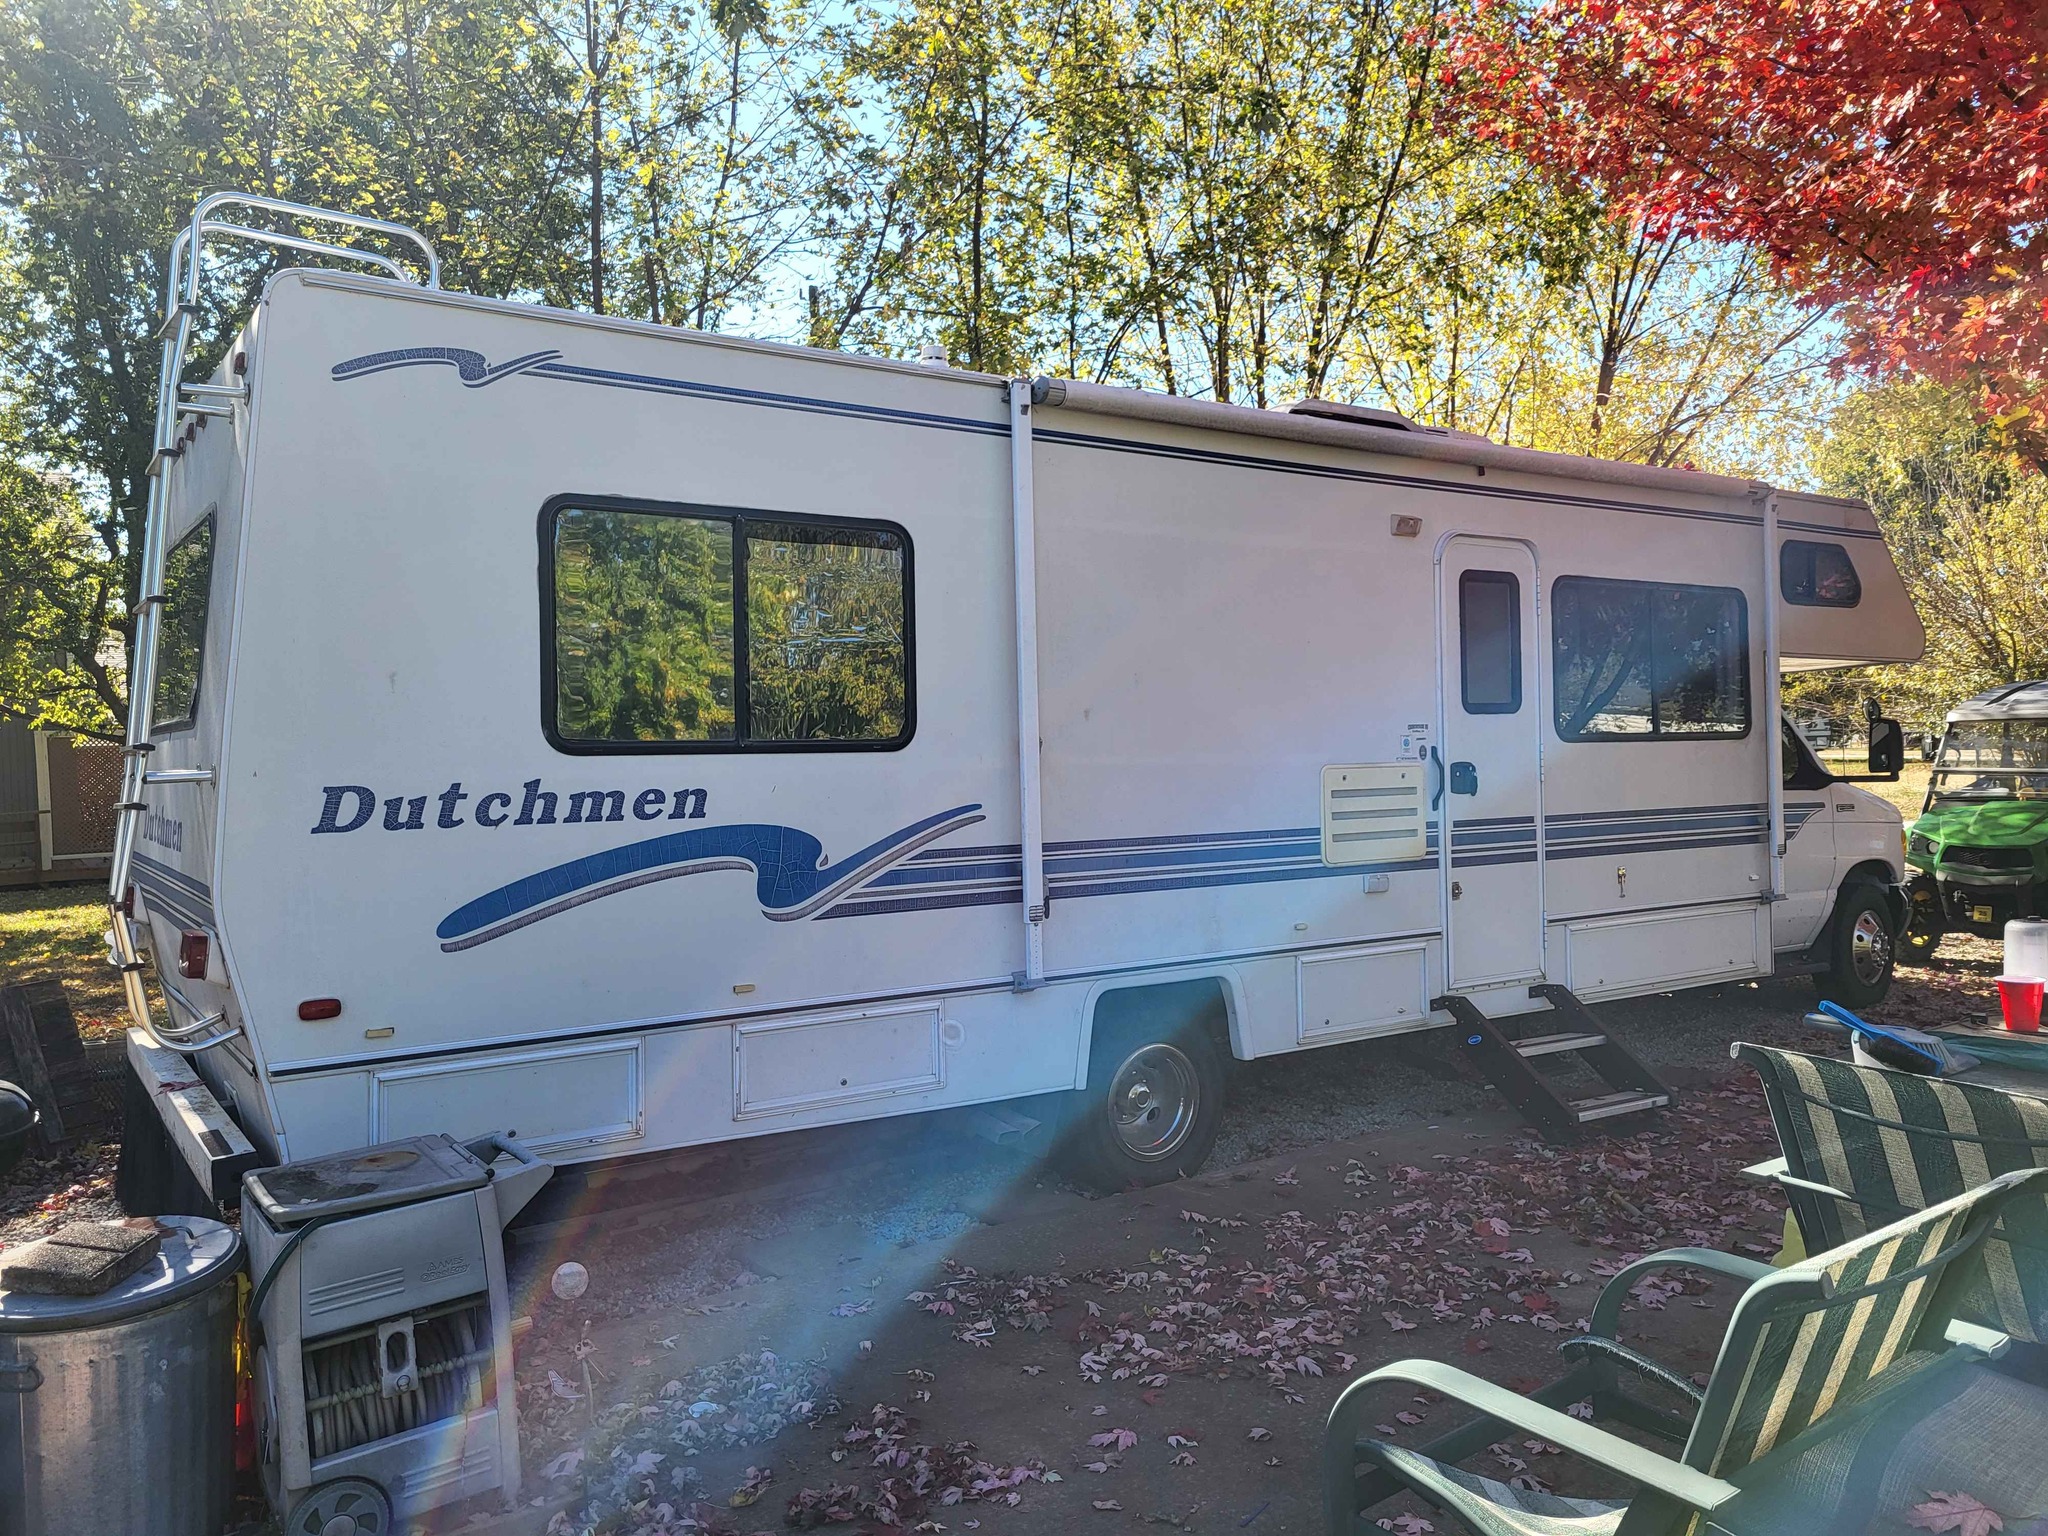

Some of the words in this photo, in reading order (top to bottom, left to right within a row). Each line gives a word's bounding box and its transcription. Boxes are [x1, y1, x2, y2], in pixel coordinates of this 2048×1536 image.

[143, 803, 183, 852] Dutchmen
[310, 778, 708, 834] Dutchmen
[437, 1256, 464, 1269] AMES
